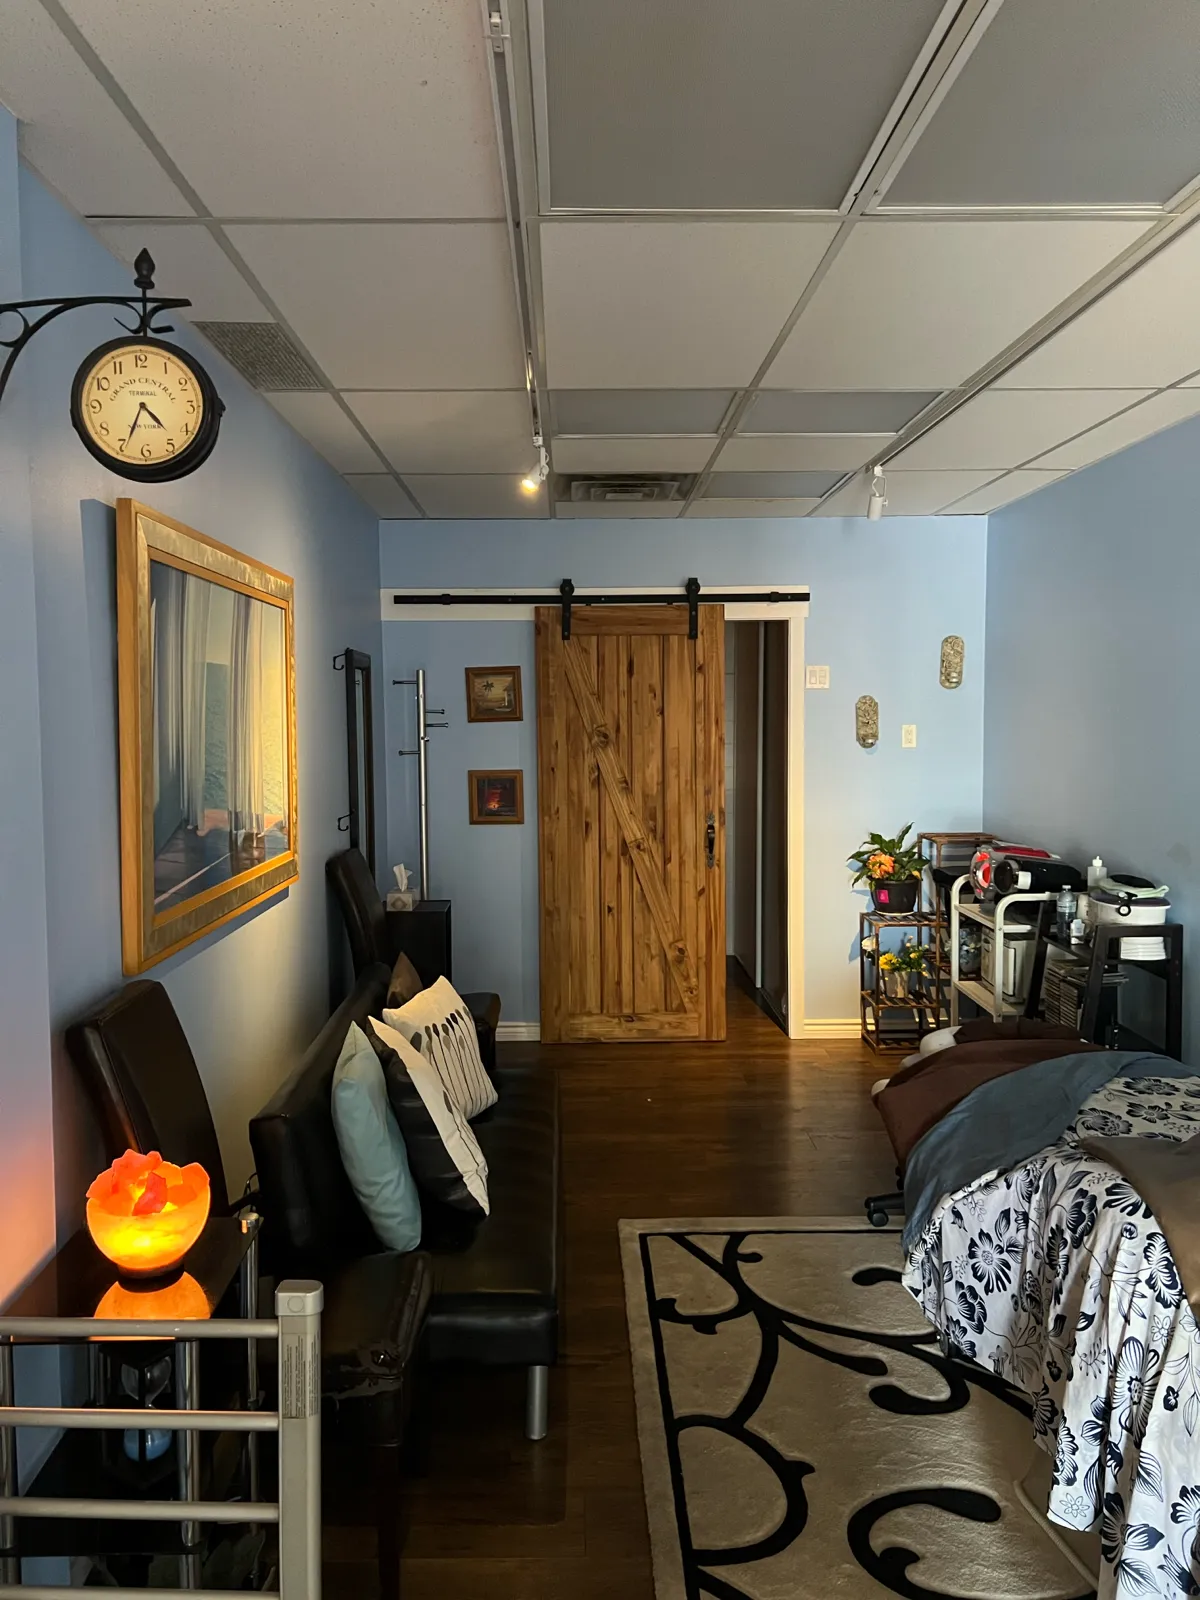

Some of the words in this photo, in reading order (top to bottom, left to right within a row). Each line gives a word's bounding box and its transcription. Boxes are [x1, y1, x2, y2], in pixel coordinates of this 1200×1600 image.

[113, 361, 122, 374] 11
[134, 354, 148, 368] 12
[164, 362, 168, 374] 1
[96, 377, 110, 391] 10
[109, 378, 136, 402] GRAND
[138, 377, 176, 404] CENTRAL
[178, 377, 188, 391] 2
[90, 399, 102, 414] 9
[186, 400, 195, 414] 3
[100, 421, 110, 436] 8
[180, 423, 192, 436] 4
[118, 438, 126, 453] 7
[140, 443, 152, 458] 6
[166, 438, 175, 454] 5
